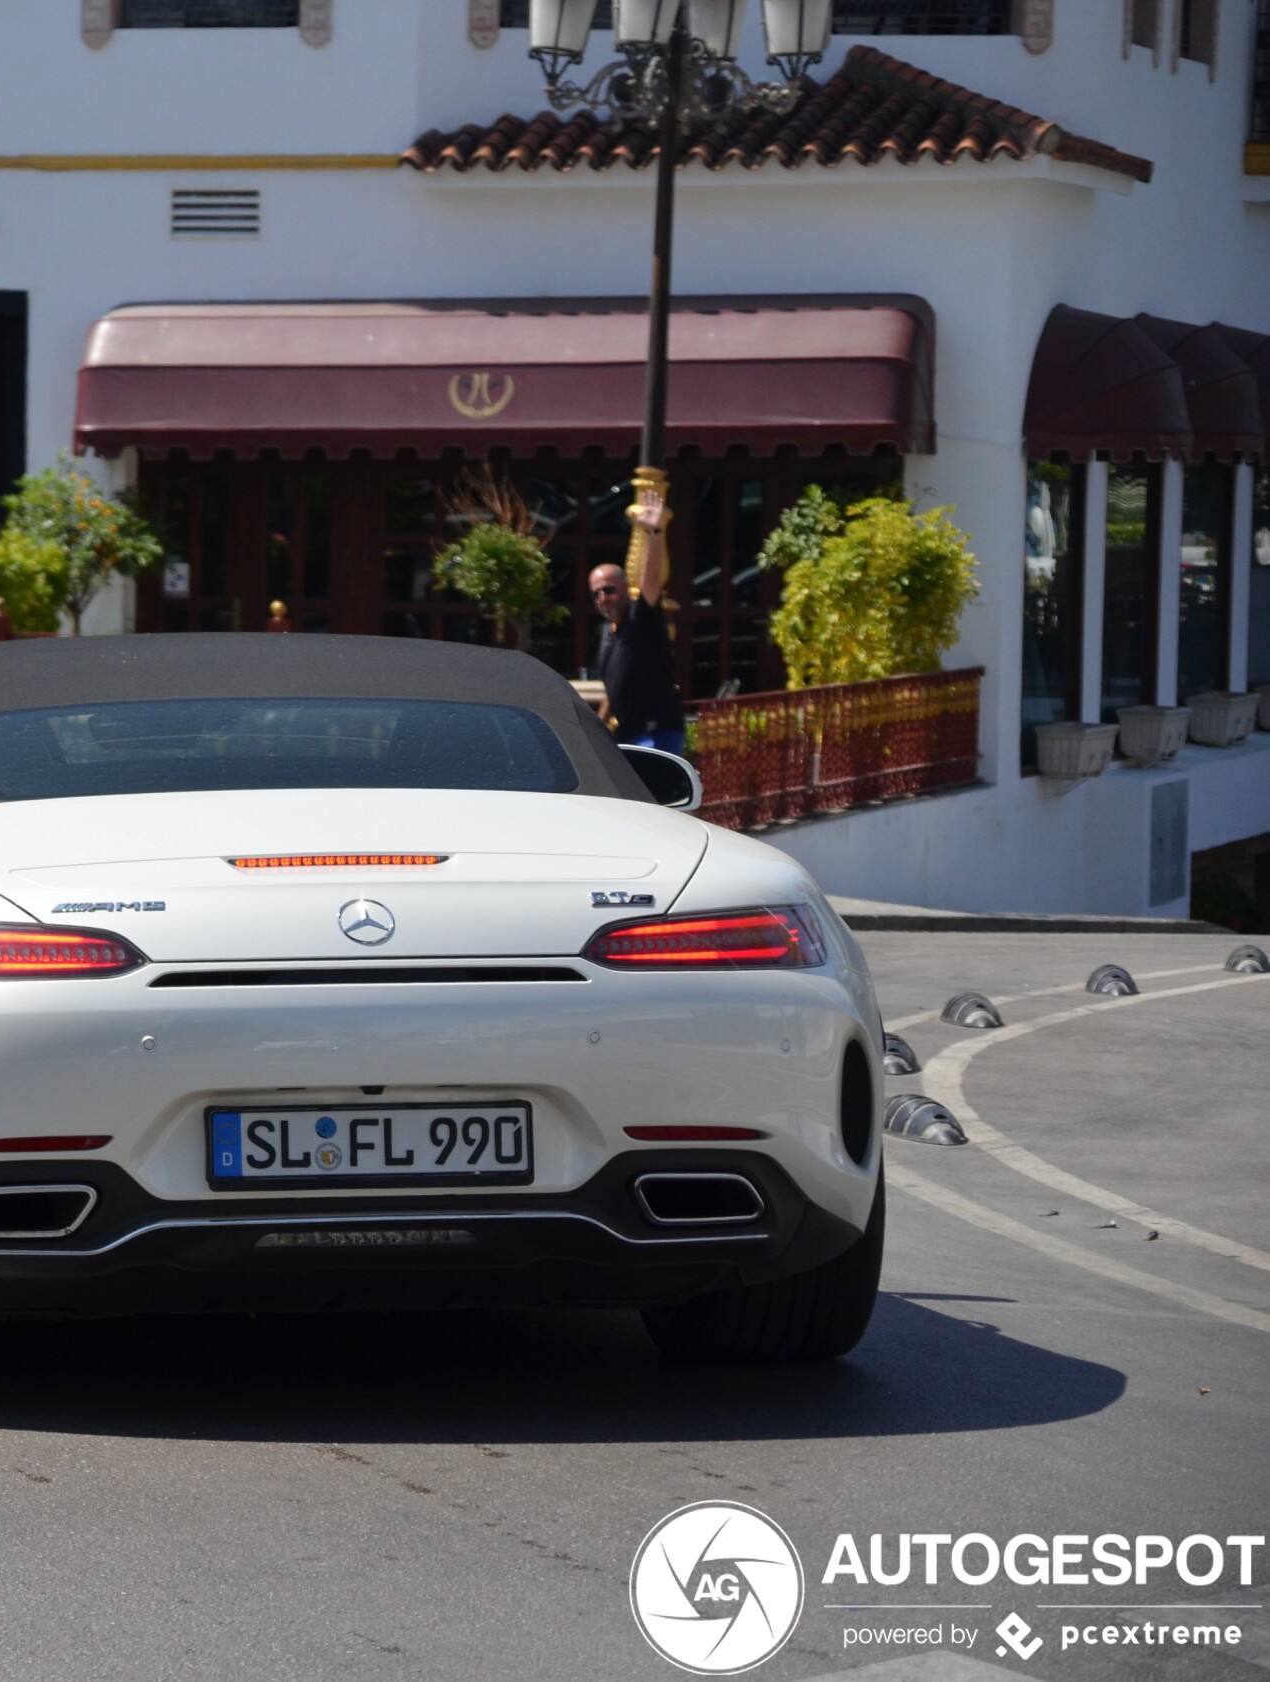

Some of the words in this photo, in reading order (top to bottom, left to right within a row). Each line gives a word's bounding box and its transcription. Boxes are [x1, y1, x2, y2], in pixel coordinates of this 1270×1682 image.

[88, 901, 166, 912] AMG
[246, 1120, 311, 1169] SL
[349, 1118, 414, 1167] FL
[430, 1116, 523, 1165] 990
[222, 1152, 233, 1167] D
